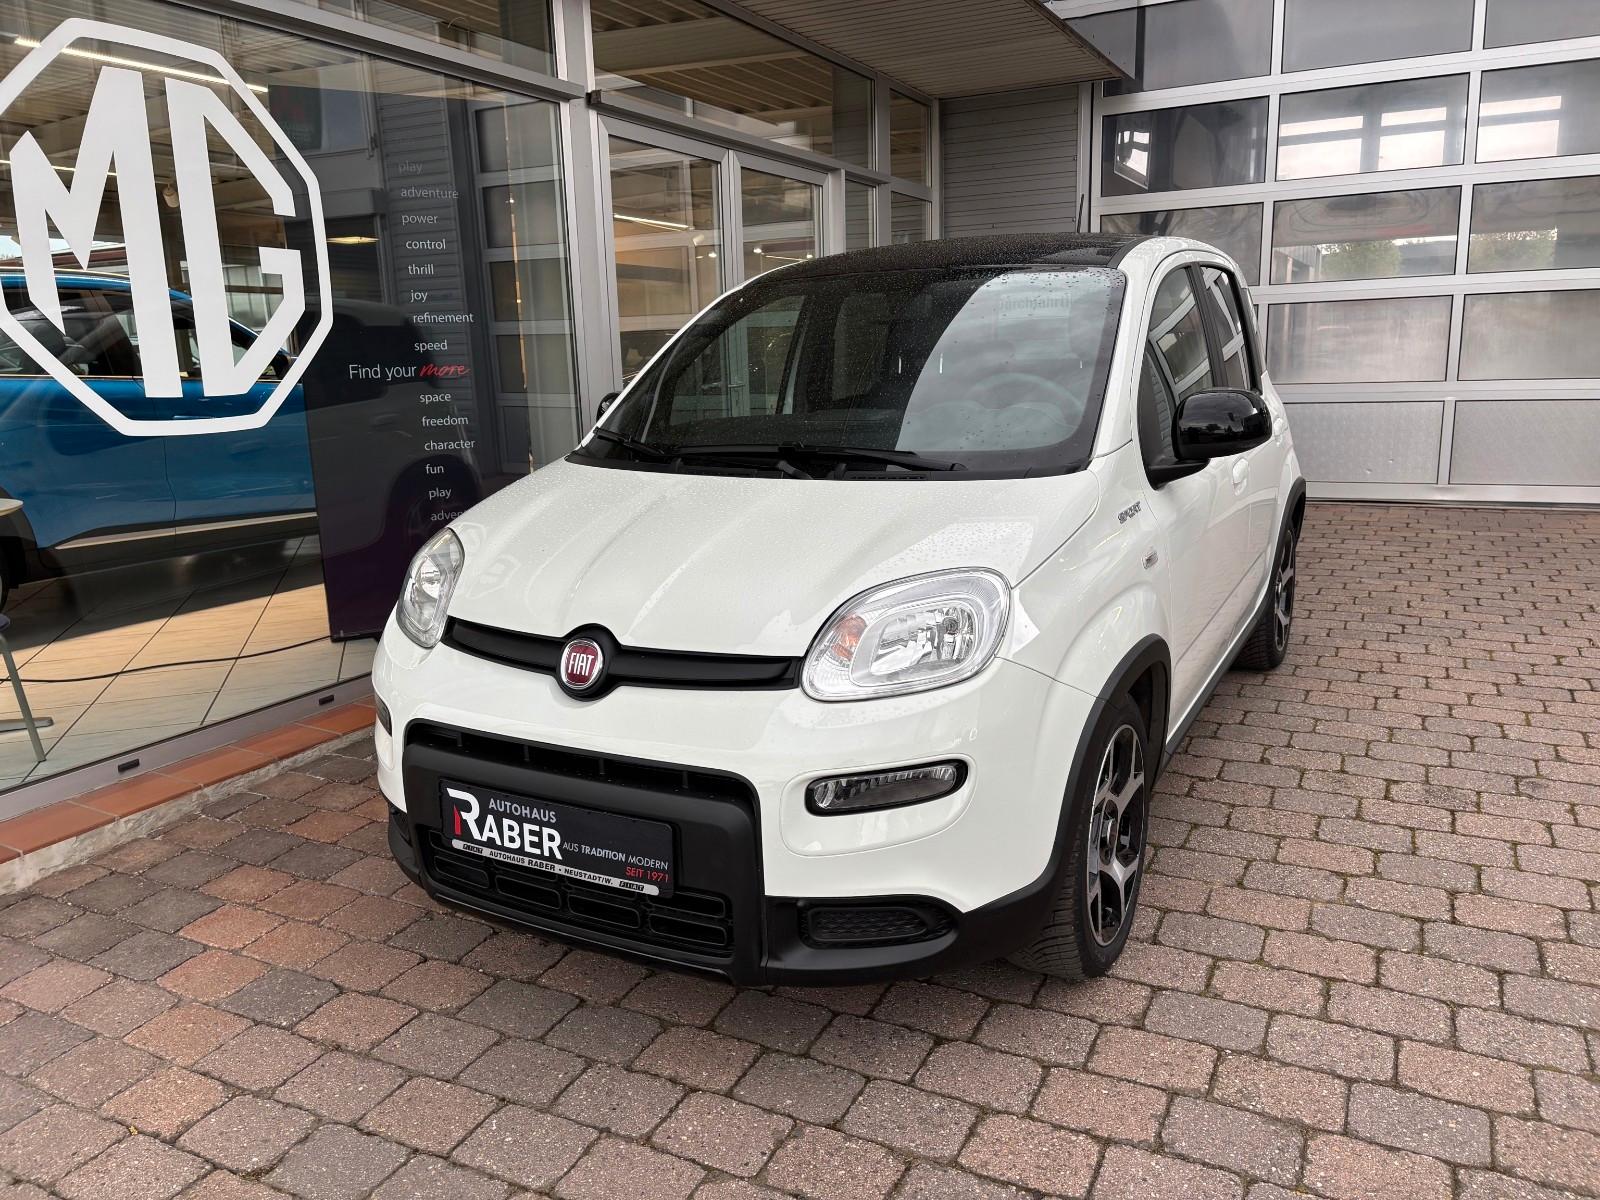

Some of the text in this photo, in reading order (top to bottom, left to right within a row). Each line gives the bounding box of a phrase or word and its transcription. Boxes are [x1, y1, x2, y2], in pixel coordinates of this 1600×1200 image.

[398, 161, 423, 174] play
[400, 186, 459, 199] adventure
[401, 214, 438, 226] power
[9, 66, 306, 398] MG
[405, 239, 446, 250] control
[408, 264, 434, 275] thrill
[410, 290, 428, 302] joy
[413, 312, 474, 323] refinement
[414, 340, 448, 352] speed
[348, 363, 471, 381] Find your more
[419, 392, 452, 404] space
[422, 416, 469, 427] freedom
[424, 439, 476, 451] character
[425, 464, 444, 474] fun
[428, 488, 452, 500] play
[567, 652, 595, 676] FIAT
[488, 798, 557, 823] AUTOHAUS
[446, 787, 563, 860] RABER
[562, 841, 669, 870] AUS TRADITION MODERN
[489, 850, 526, 865] AUTOHAUS
[527, 858, 556, 872] RABER
[564, 867, 614, 886] NEUSTADT/W.
[625, 866, 669, 883] SEIT 1971
